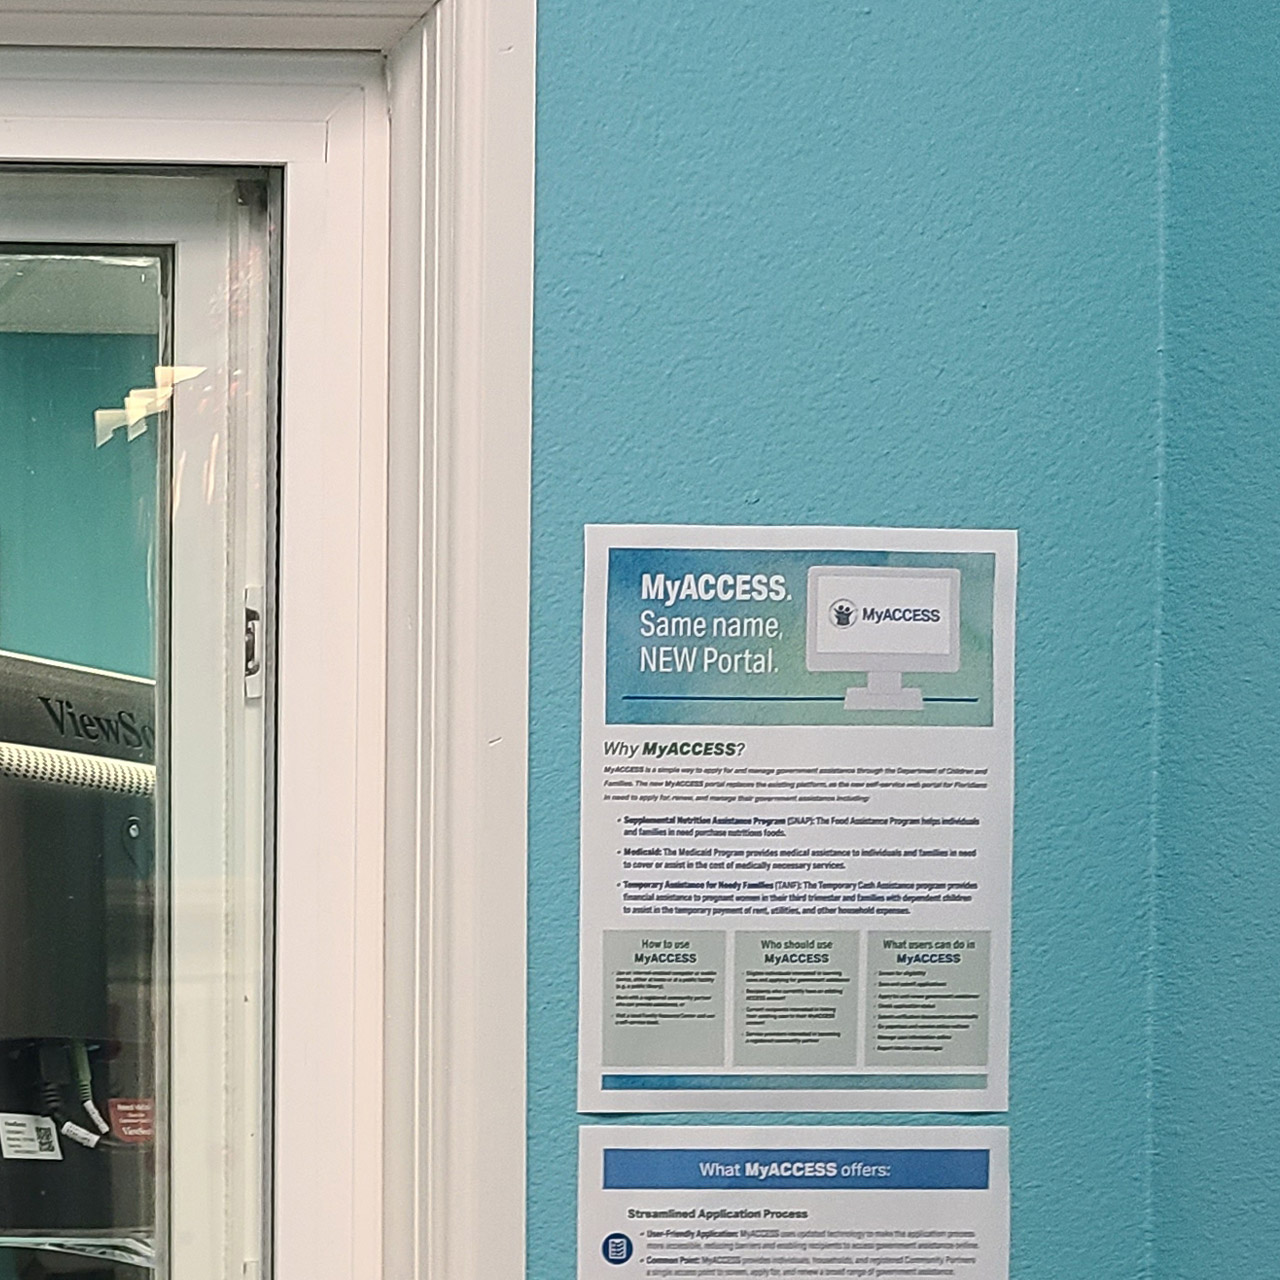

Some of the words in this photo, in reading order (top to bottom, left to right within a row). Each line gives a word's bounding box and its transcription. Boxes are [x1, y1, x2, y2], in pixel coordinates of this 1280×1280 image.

[642, 573, 792, 607] MyACCESS.
[862, 607, 940, 624] MyACCESS
[641, 610, 706, 637] Same
[713, 617, 783, 640] name,
[641, 646, 697, 672] NEW
[704, 647, 779, 673] Portal.
[604, 741, 639, 759] Why
[642, 742, 745, 759] MyACCESS?
[642, 939, 662, 949] How
[663, 940, 673, 949] to
[674, 941, 690, 949] use
[761, 940, 782, 949] Who
[784, 940, 815, 949] should
[817, 941, 833, 949] use
[883, 939, 907, 949] What
[908, 941, 934, 950] users
[934, 941, 952, 949] can
[953, 940, 965, 949] do
[966, 940, 975, 949] in
[634, 953, 697, 965] MyACCESS
[764, 953, 829, 966] MyACCESS
[897, 953, 961, 966] MyACCESS
[699, 1162, 741, 1177] What
[745, 1162, 837, 1179] MyACCESS
[841, 1162, 891, 1177] offers:
[628, 1209, 696, 1219] Streamlined
[697, 1209, 761, 1221] Application
[763, 1209, 808, 1219] Process
